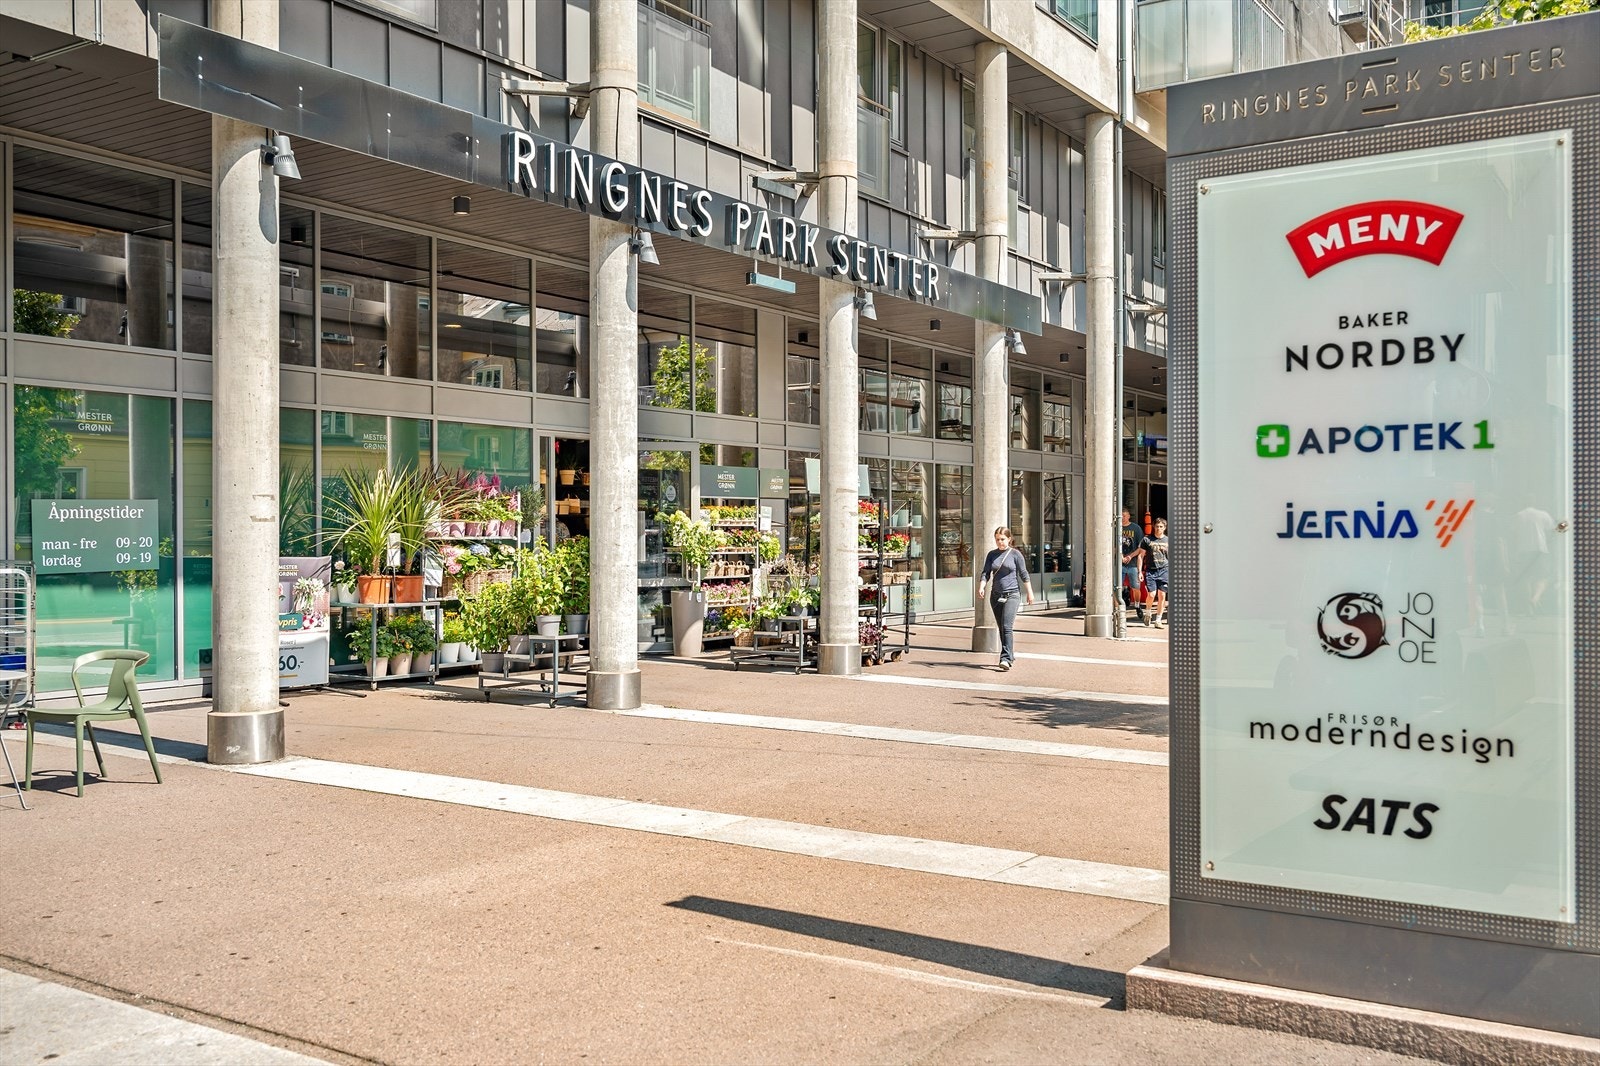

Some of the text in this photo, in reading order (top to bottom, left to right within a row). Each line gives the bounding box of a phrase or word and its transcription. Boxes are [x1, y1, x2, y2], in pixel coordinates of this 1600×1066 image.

[1201, 45, 1567, 124] RINGNES PARK SENTER
[507, 130, 940, 301] RINGNES PARK SENTER
[1307, 213, 1444, 259] MENY
[1338, 310, 1410, 330] BAKER
[1285, 333, 1466, 373] NORDBY
[76, 411, 112, 422] MESTER
[77, 422, 112, 433] GRØNN
[363, 433, 388, 441] MESTER
[1297, 420, 1466, 456] APOTEK
[48, 501, 145, 523] Åpningstider
[42, 540, 70, 551] man
[80, 537, 98, 550] fre
[116, 537, 131, 549] 09
[139, 536, 153, 549] 20
[42, 554, 82, 568] lørdag
[116, 552, 131, 564] 09
[139, 551, 152, 563] 19
[1398, 591, 1434, 616] JO
[1398, 639, 1437, 664] OE
[1327, 712, 1400, 728] FRISØR
[1250, 717, 1515, 764] moderndesign
[1313, 793, 1441, 840] SATS
